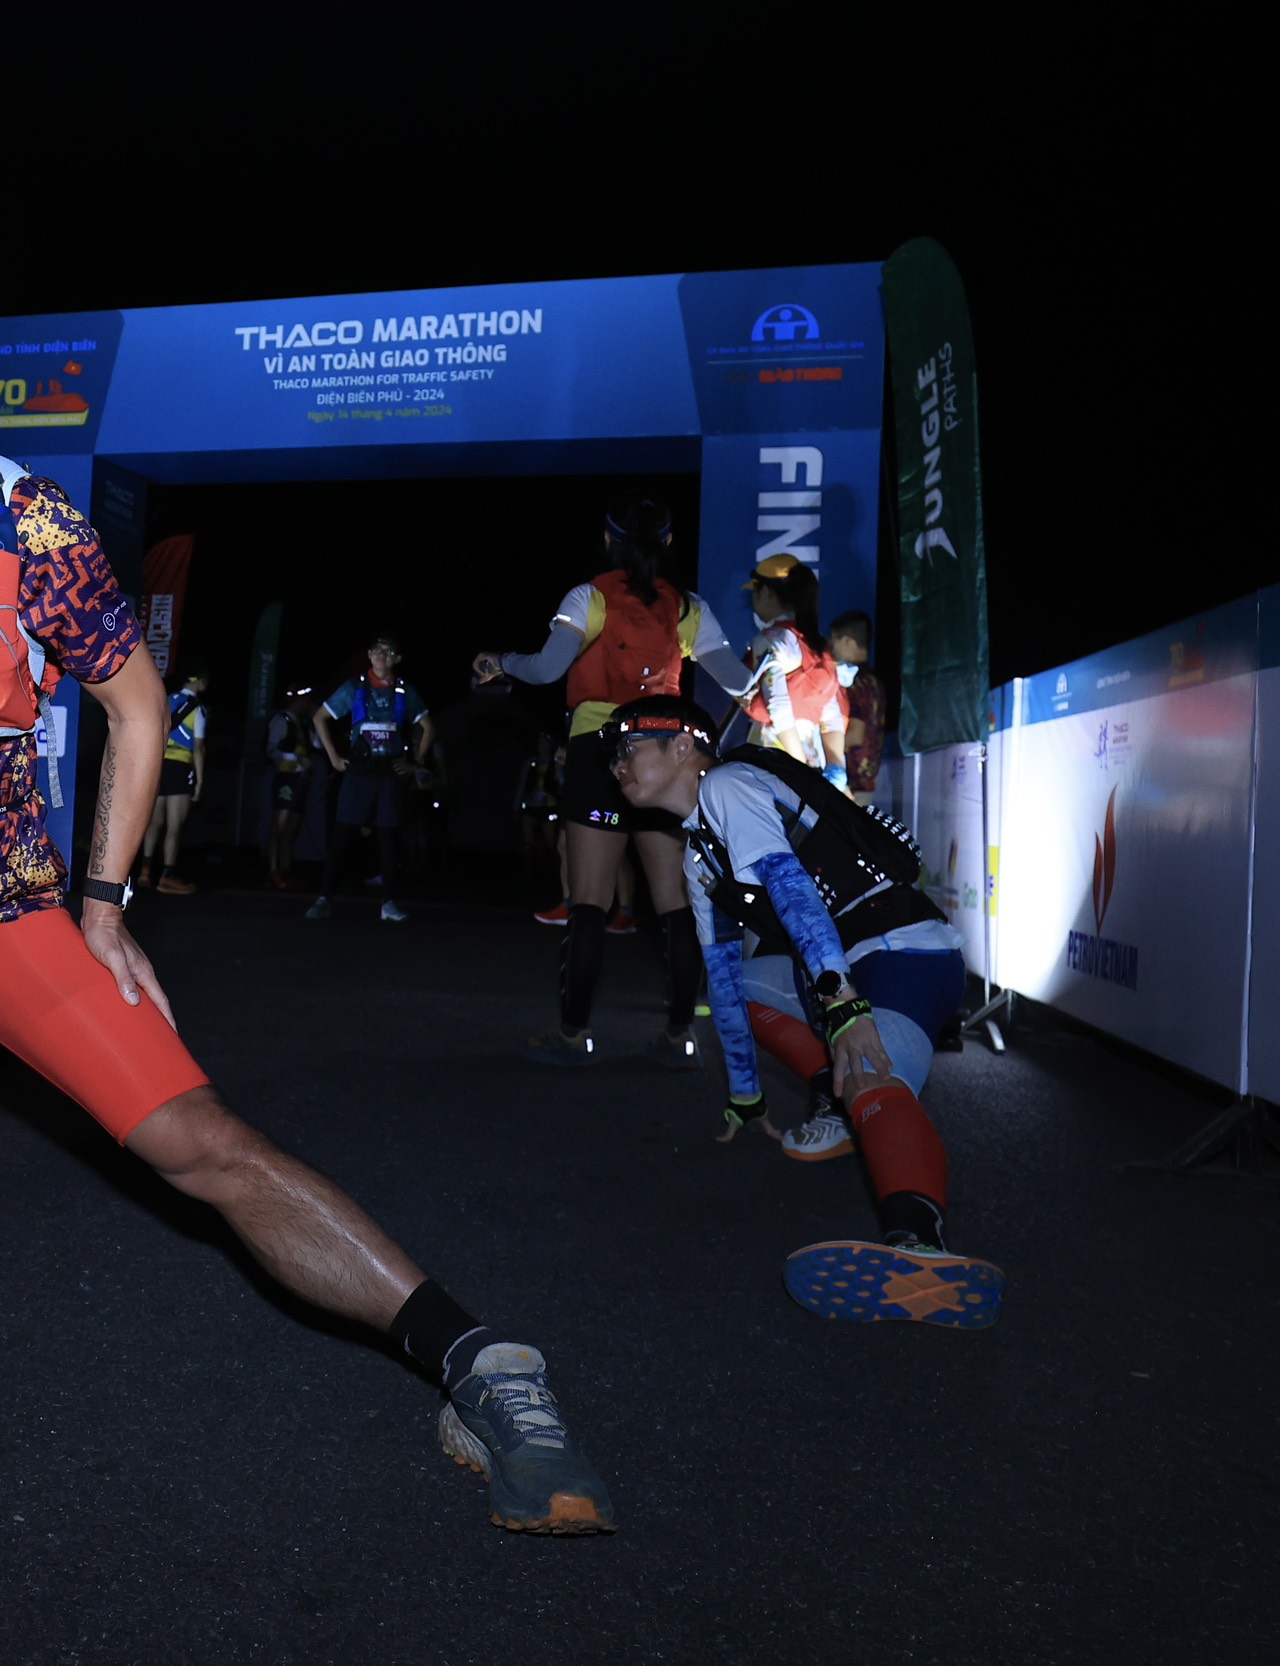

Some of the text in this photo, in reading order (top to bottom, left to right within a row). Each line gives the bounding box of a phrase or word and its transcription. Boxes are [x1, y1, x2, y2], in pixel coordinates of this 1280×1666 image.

[234, 308, 543, 351] THACO MARATHON
[263, 342, 508, 375] VÌ AN TOÀN GIAO THÔNG
[273, 368, 494, 391] THACO MARATHON FOR TRAFFIC SAFETY
[347, 390, 374, 404] BIÊN
[413, 389, 445, 401] 2024
[938, 342, 963, 432] PATHS
[914, 356, 958, 568] JUNGLE
[755, 446, 823, 581] FIN
[604, 811, 620, 826] T8
[1067, 930, 1139, 991] PETROVIETNAM
